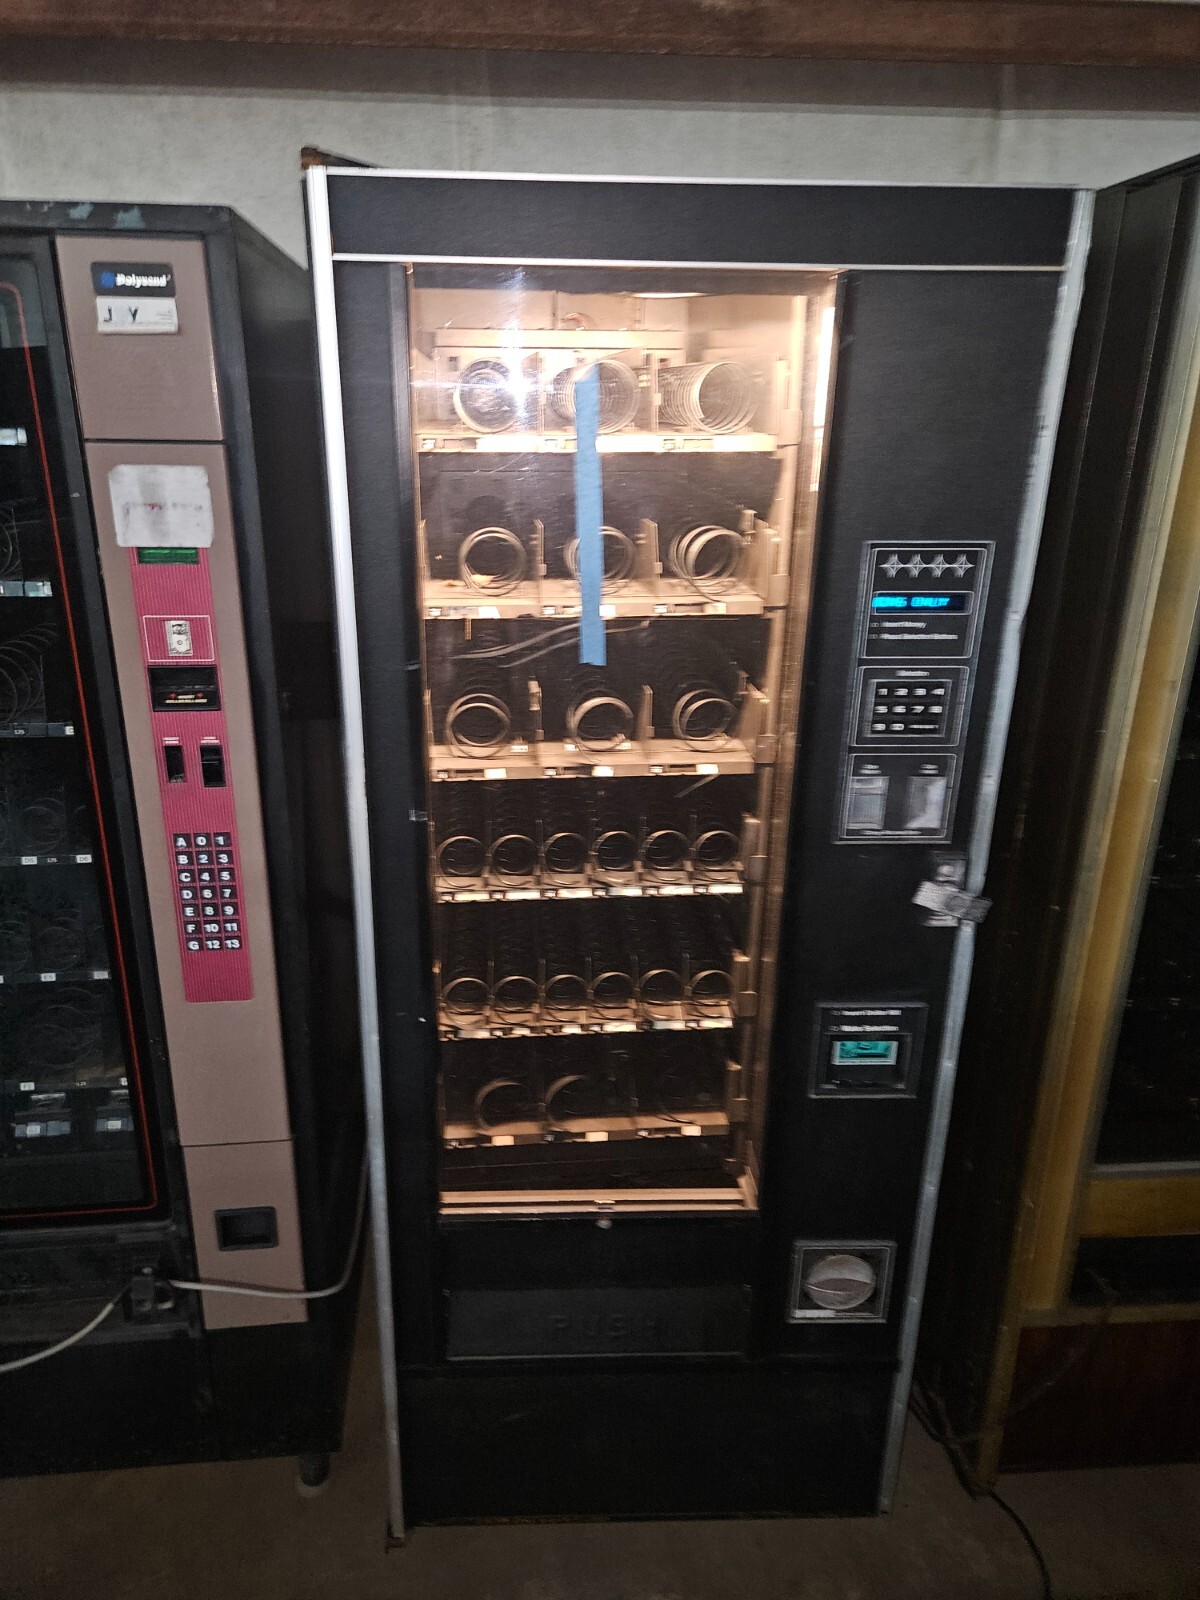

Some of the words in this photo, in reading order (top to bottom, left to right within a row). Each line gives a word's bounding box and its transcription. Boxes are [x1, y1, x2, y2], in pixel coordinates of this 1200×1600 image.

[894, 688, 908, 696] 2
[912, 688, 927, 696] 3
[930, 688, 945, 696] 4
[874, 705, 888, 713] 5
[892, 705, 906, 713] 6
[910, 705, 925, 713] 7
[927, 705, 943, 713] 8
[871, 723, 886, 731] 9
[889, 723, 905, 731] 0
[176, 837, 187, 847] A
[196, 836, 206, 846] 0
[215, 836, 225, 845] 1
[177, 855, 188, 864] B
[198, 854, 209, 863] 2
[218, 853, 229, 863] 3
[180, 872, 191, 882] C
[200, 872, 210, 881] 4
[220, 871, 230, 880] 5
[181, 889, 193, 899] D
[202, 889, 212, 898] 6
[222, 888, 232, 898] 7
[184, 907, 195, 916] E
[204, 906, 214, 916] 8
[224, 905, 234, 915] 9
[186, 924, 196, 933] F
[203, 923, 219, 933] 10
[224, 922, 237, 932] 11
[187, 941, 199, 950] G
[205, 940, 220, 949] 12
[224, 939, 240, 949] 13
